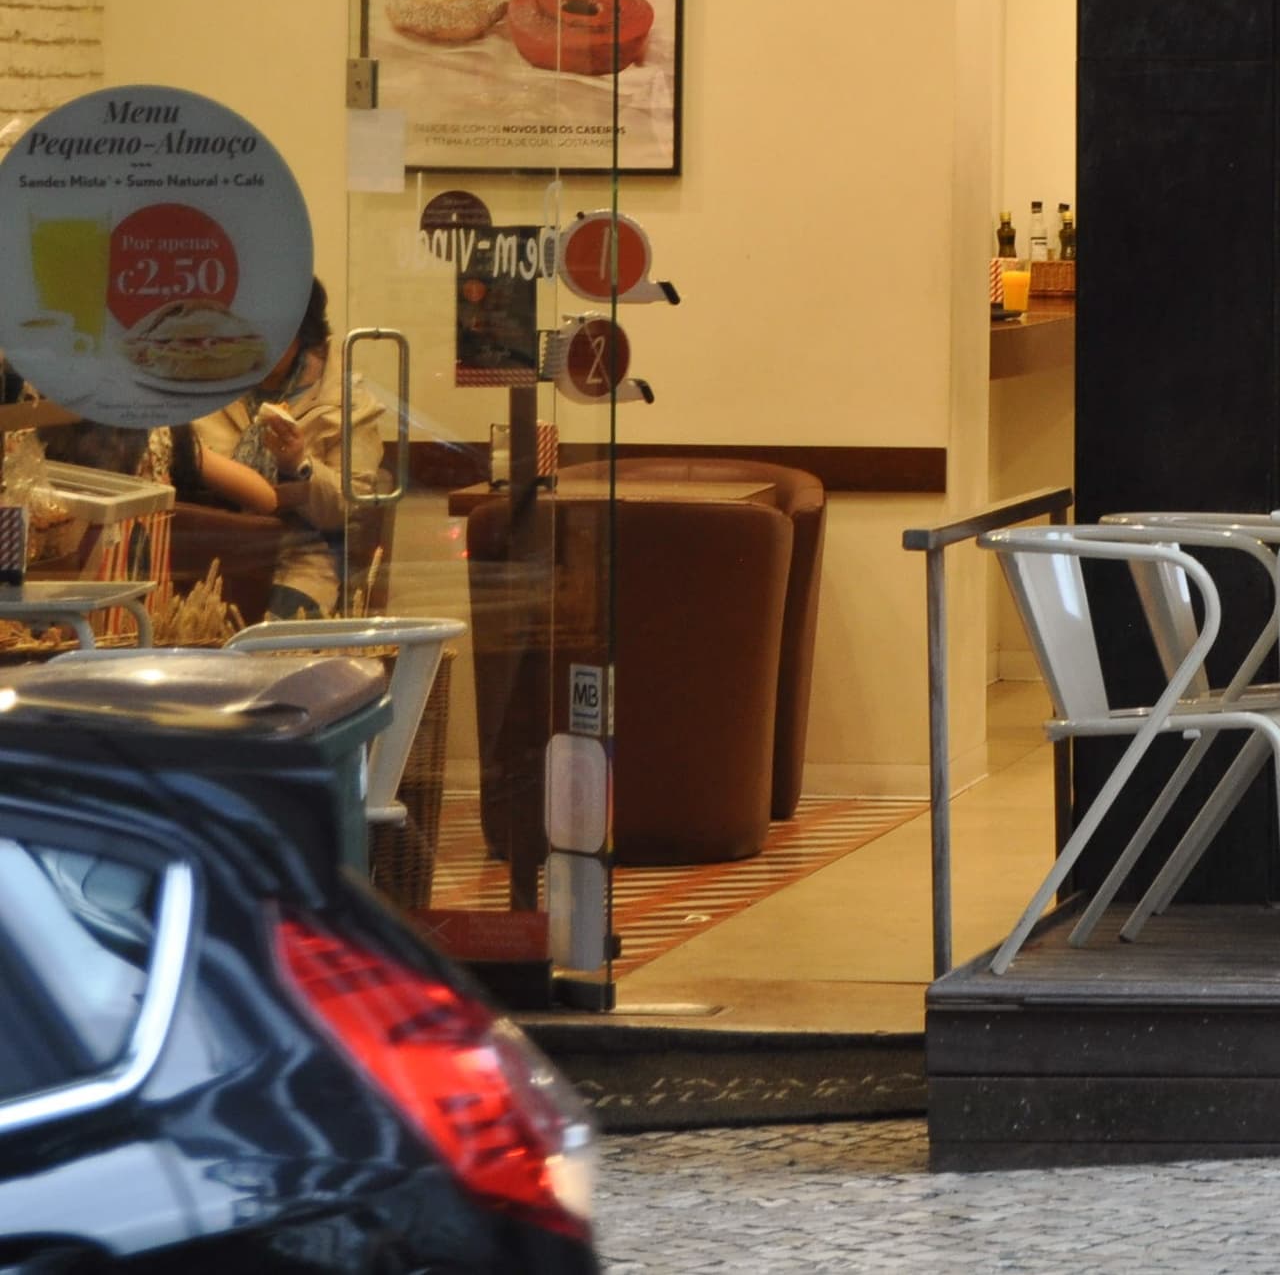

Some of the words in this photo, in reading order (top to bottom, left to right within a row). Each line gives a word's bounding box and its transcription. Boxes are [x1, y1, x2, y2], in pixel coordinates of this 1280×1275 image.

[103, 100, 181, 125] Menu
[502, 125, 537, 135] NOVOS
[576, 125, 627, 135] CASEIRS
[26, 128, 257, 160] Pequeno-Almoço
[18, 175, 66, 188] Sandes
[126, 175, 164, 188] Sumo
[167, 174, 218, 187] Natural
[233, 173, 265, 187] Café
[122, 235, 151, 251] Por
[157, 237, 219, 253] apenas
[572, 682, 598, 708] MB
